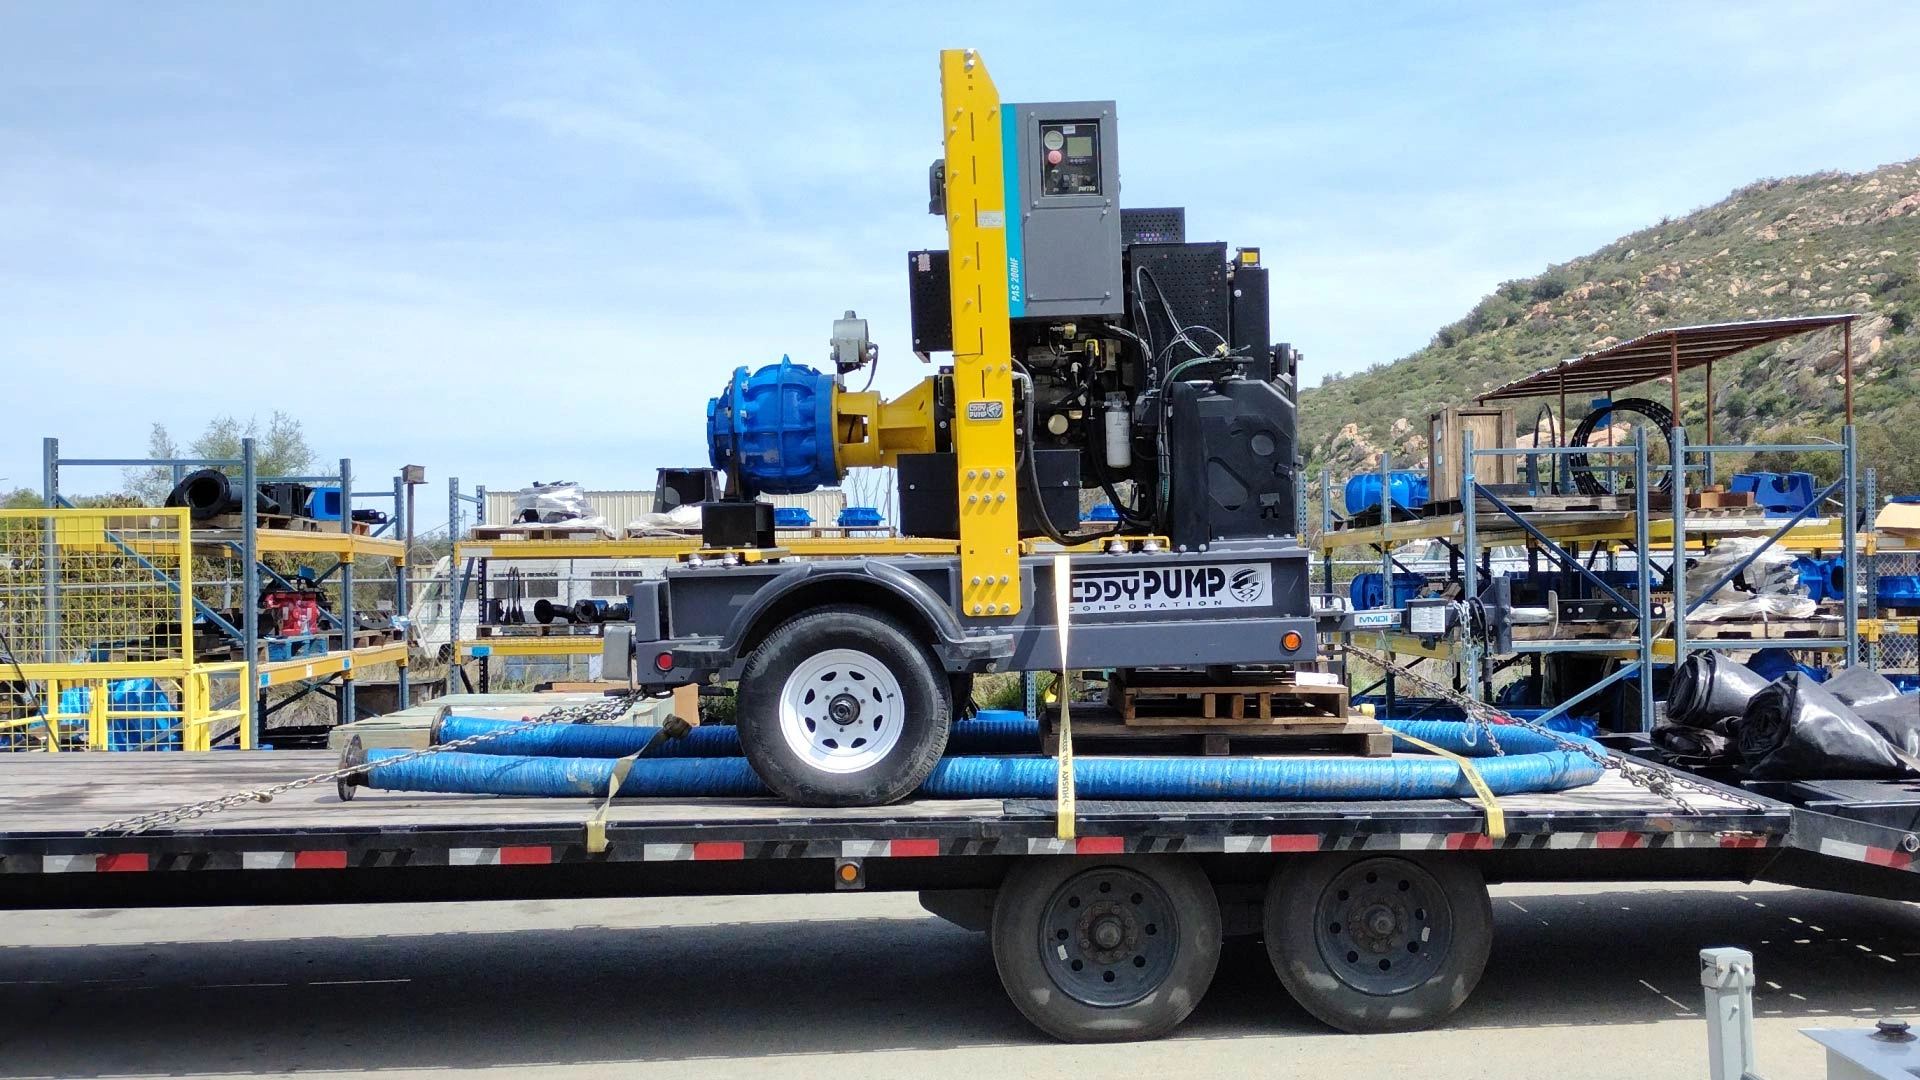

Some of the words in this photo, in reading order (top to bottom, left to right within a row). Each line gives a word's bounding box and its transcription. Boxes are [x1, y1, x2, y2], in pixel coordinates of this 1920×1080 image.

[1010, 257, 1019, 283] 200HF
[1011, 284, 1020, 302] PAS
[1070, 600, 1222, 612] CORPORATION
[1359, 615, 1389, 623] MMDI
[1062, 770, 1070, 799] HUSKY
